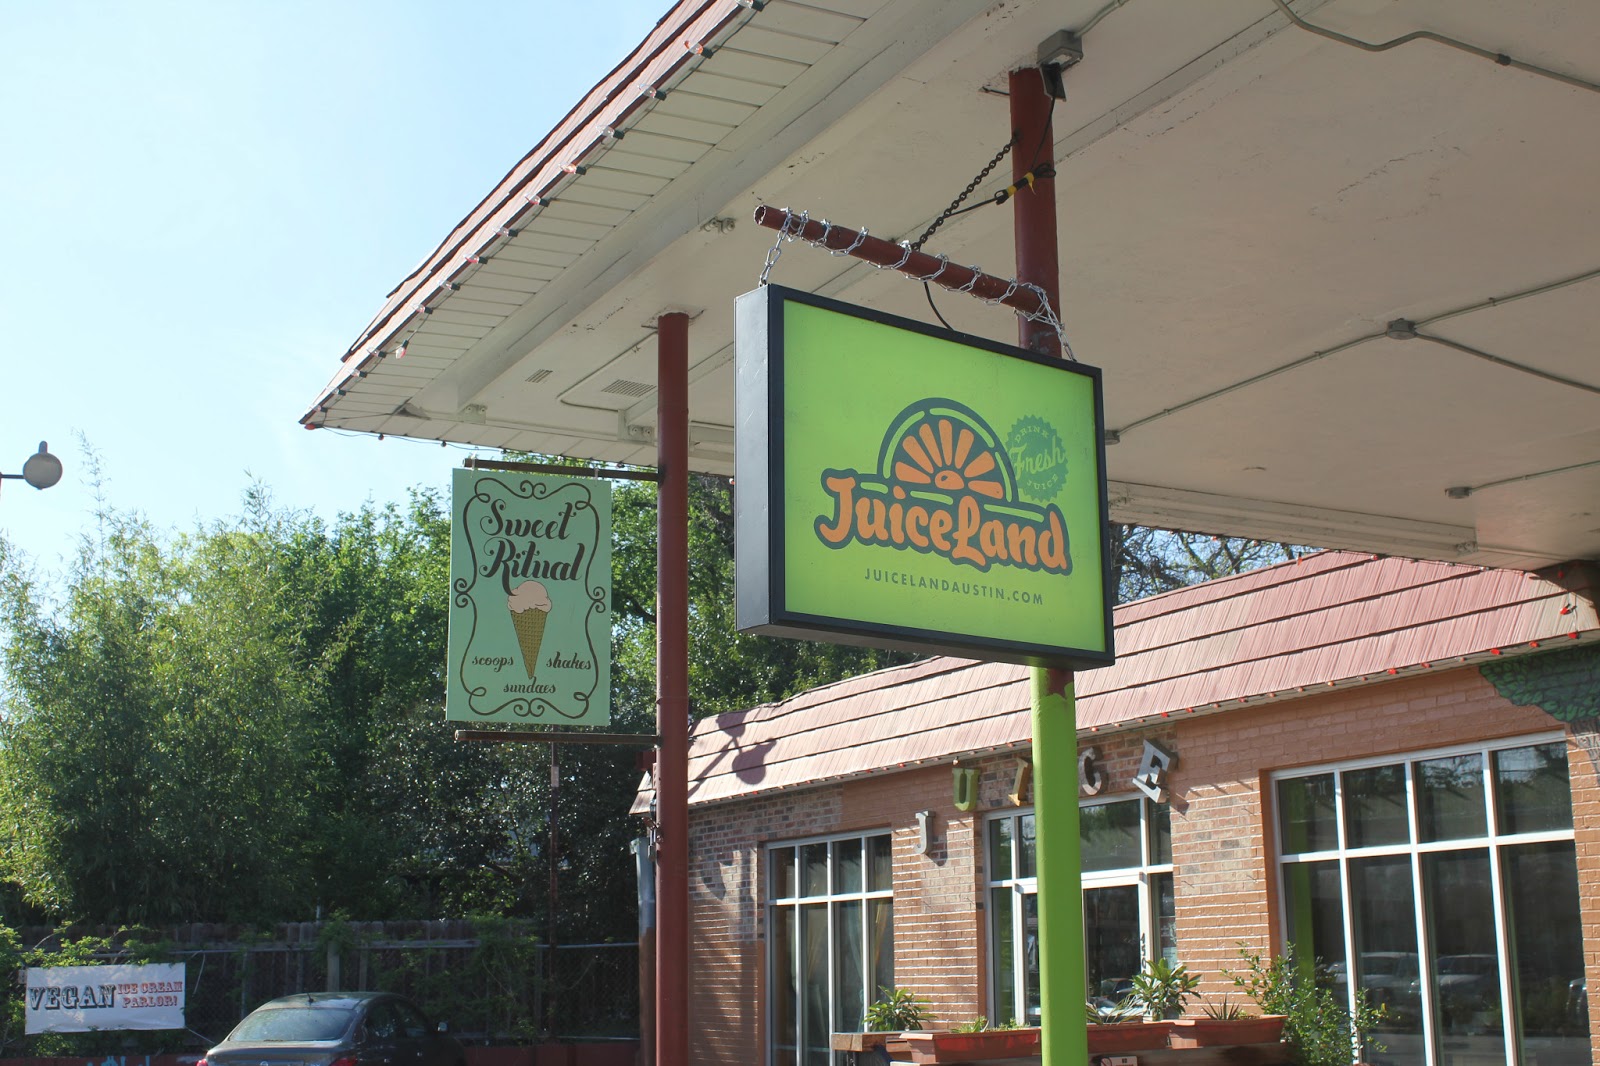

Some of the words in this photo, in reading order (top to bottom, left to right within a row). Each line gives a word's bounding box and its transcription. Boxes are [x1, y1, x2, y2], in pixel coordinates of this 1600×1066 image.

[1015, 425, 1049, 443] DRINK
[1009, 434, 1065, 481] Fresh
[1026, 473, 1059, 490] JUICE
[480, 498, 577, 540] Sweet
[815, 470, 1071, 573] JuiceLand
[479, 537, 585, 596] Ritual
[864, 568, 1043, 605] JUICELANDAUSTIN.COM
[472, 655, 514, 673] scoops
[546, 651, 591, 670] shakes
[503, 675, 556, 694] sundaes
[28, 984, 116, 1010] VEGAN
[117, 983, 138, 995] ICE
[141, 981, 183, 993] CREAM
[122, 995, 178, 1008] PARLOR!
